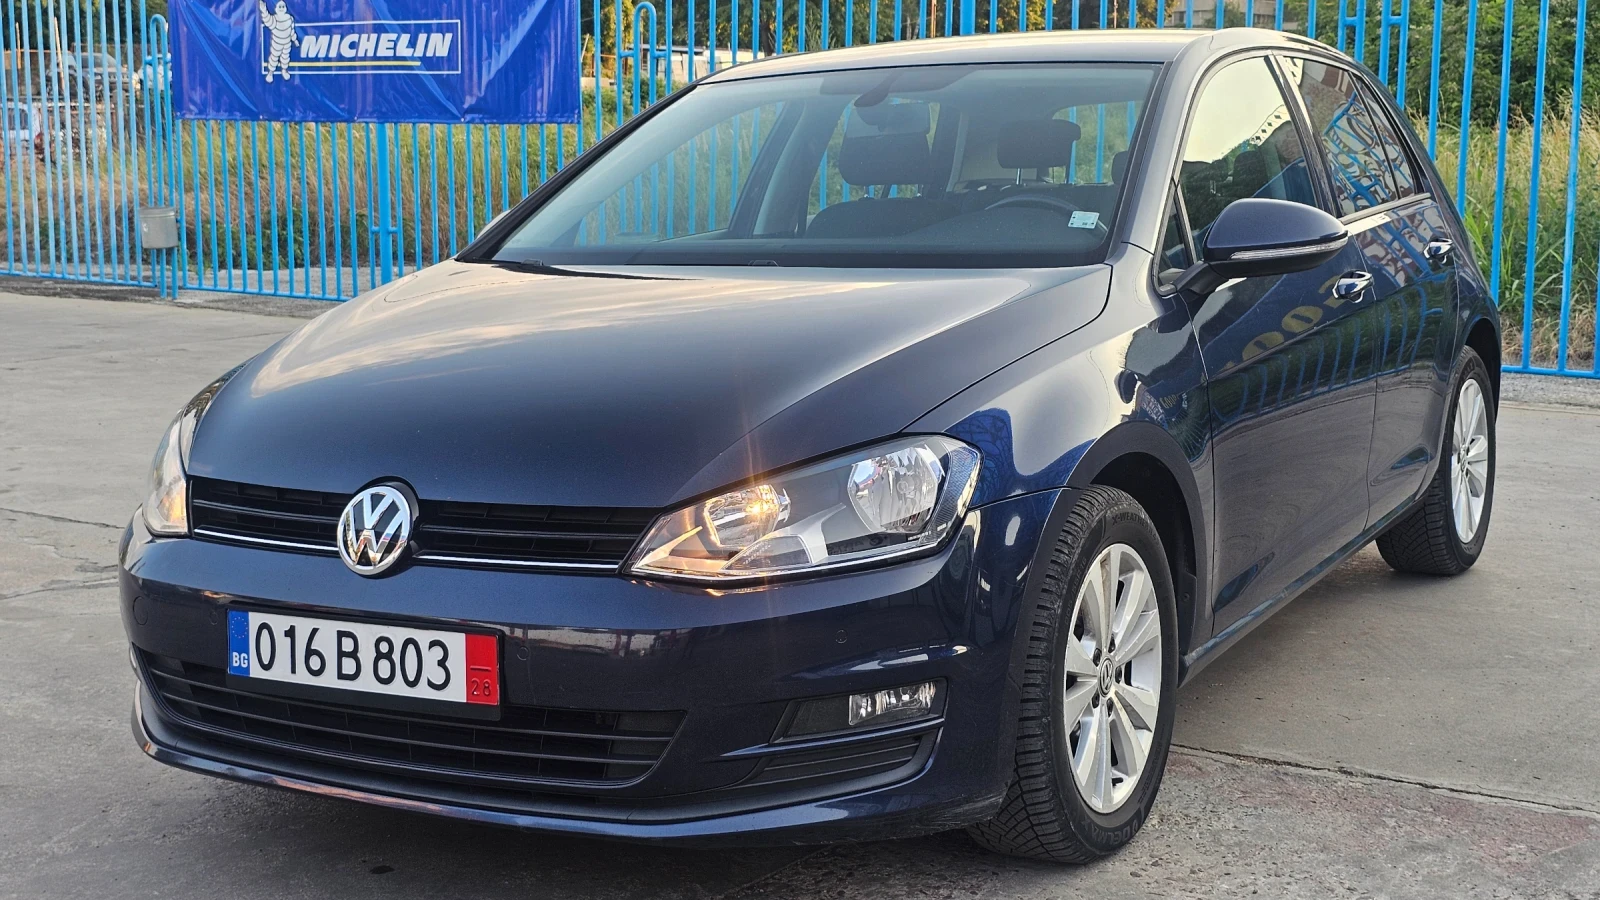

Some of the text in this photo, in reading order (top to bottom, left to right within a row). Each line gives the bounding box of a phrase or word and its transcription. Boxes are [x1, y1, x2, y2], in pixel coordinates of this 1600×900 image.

[300, 33, 453, 58] MICHELIN
[339, 487, 408, 573] VW
[232, 651, 248, 668] BG
[471, 678, 491, 696] 28
